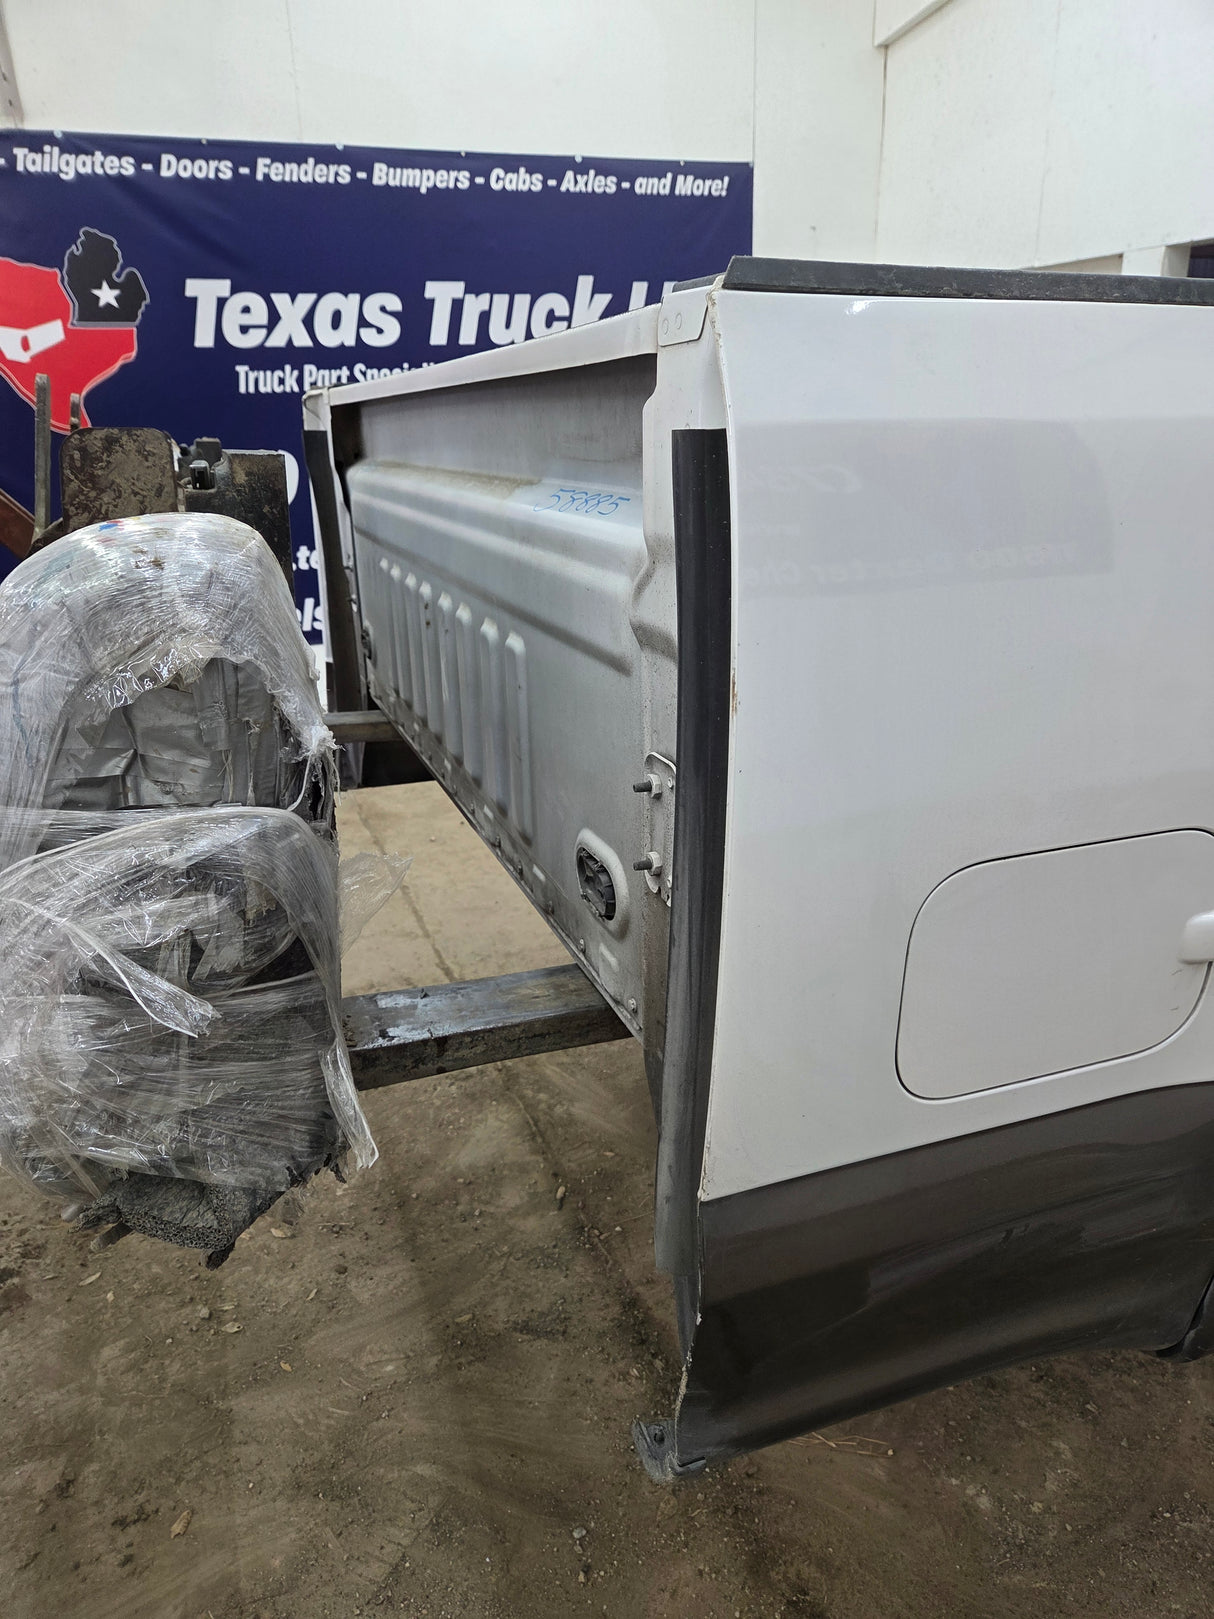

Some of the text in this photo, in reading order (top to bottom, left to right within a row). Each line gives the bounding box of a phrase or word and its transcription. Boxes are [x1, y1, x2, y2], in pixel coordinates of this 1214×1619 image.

[13, 145, 135, 180] Tailgates
[160, 153, 233, 180] Doors
[256, 157, 351, 184] Fenders
[372, 162, 470, 194] Bumpers
[489, 166, 543, 192] Cabs
[560, 169, 617, 194] Axles
[634, 172, 673, 196] and
[674, 174, 730, 197] More!
[185, 278, 402, 348] Texas
[424, 274, 613, 345] Truck
[236, 364, 299, 394] Truck
[303, 363, 350, 391] Part
[533, 488, 631, 516] 58885
